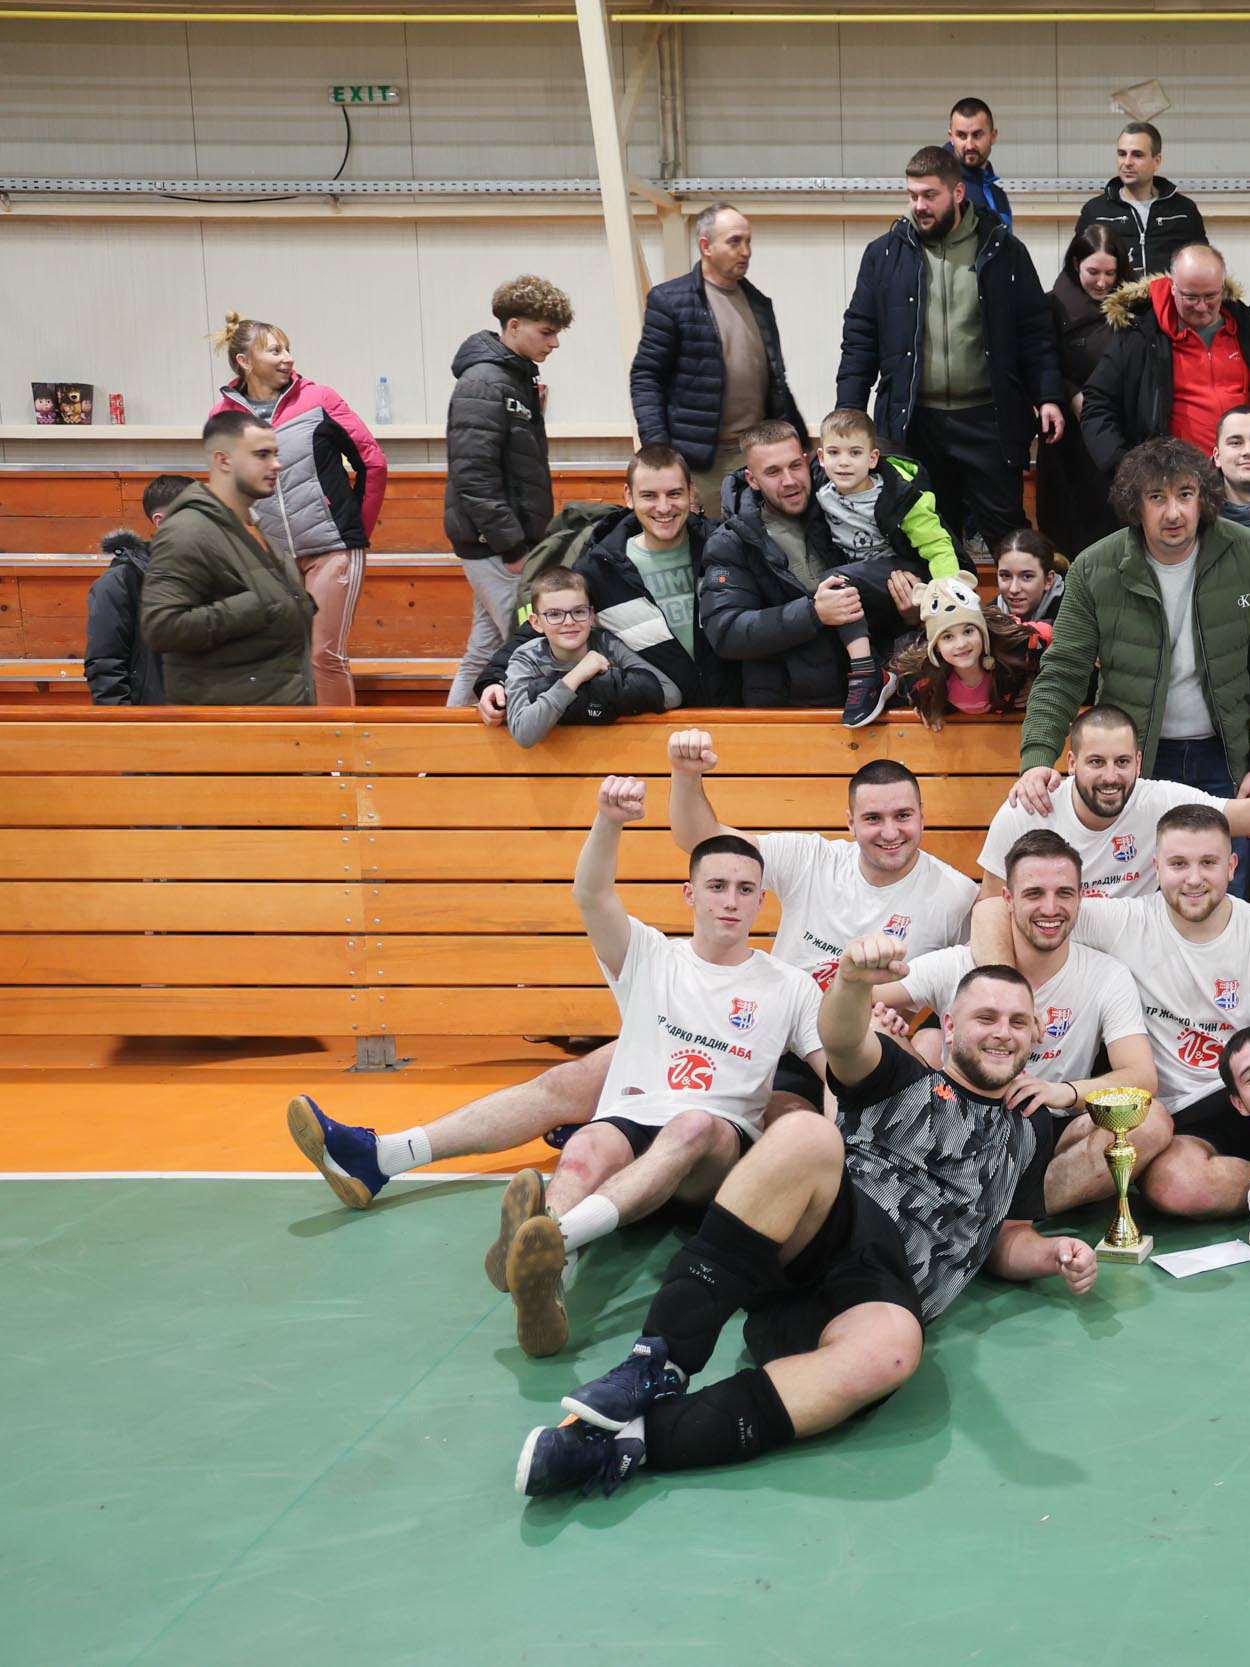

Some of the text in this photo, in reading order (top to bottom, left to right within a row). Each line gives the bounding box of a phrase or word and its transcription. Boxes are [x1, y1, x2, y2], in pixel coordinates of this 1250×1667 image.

[333, 86, 390, 101] EXIT
[803, 931, 814, 942] ТР
[1146, 1006, 1158, 1016] ТР
[694, 1035, 729, 1052] РАДИН
[728, 1045, 752, 1061] АБА
[668, 1057, 714, 1091] V&S
